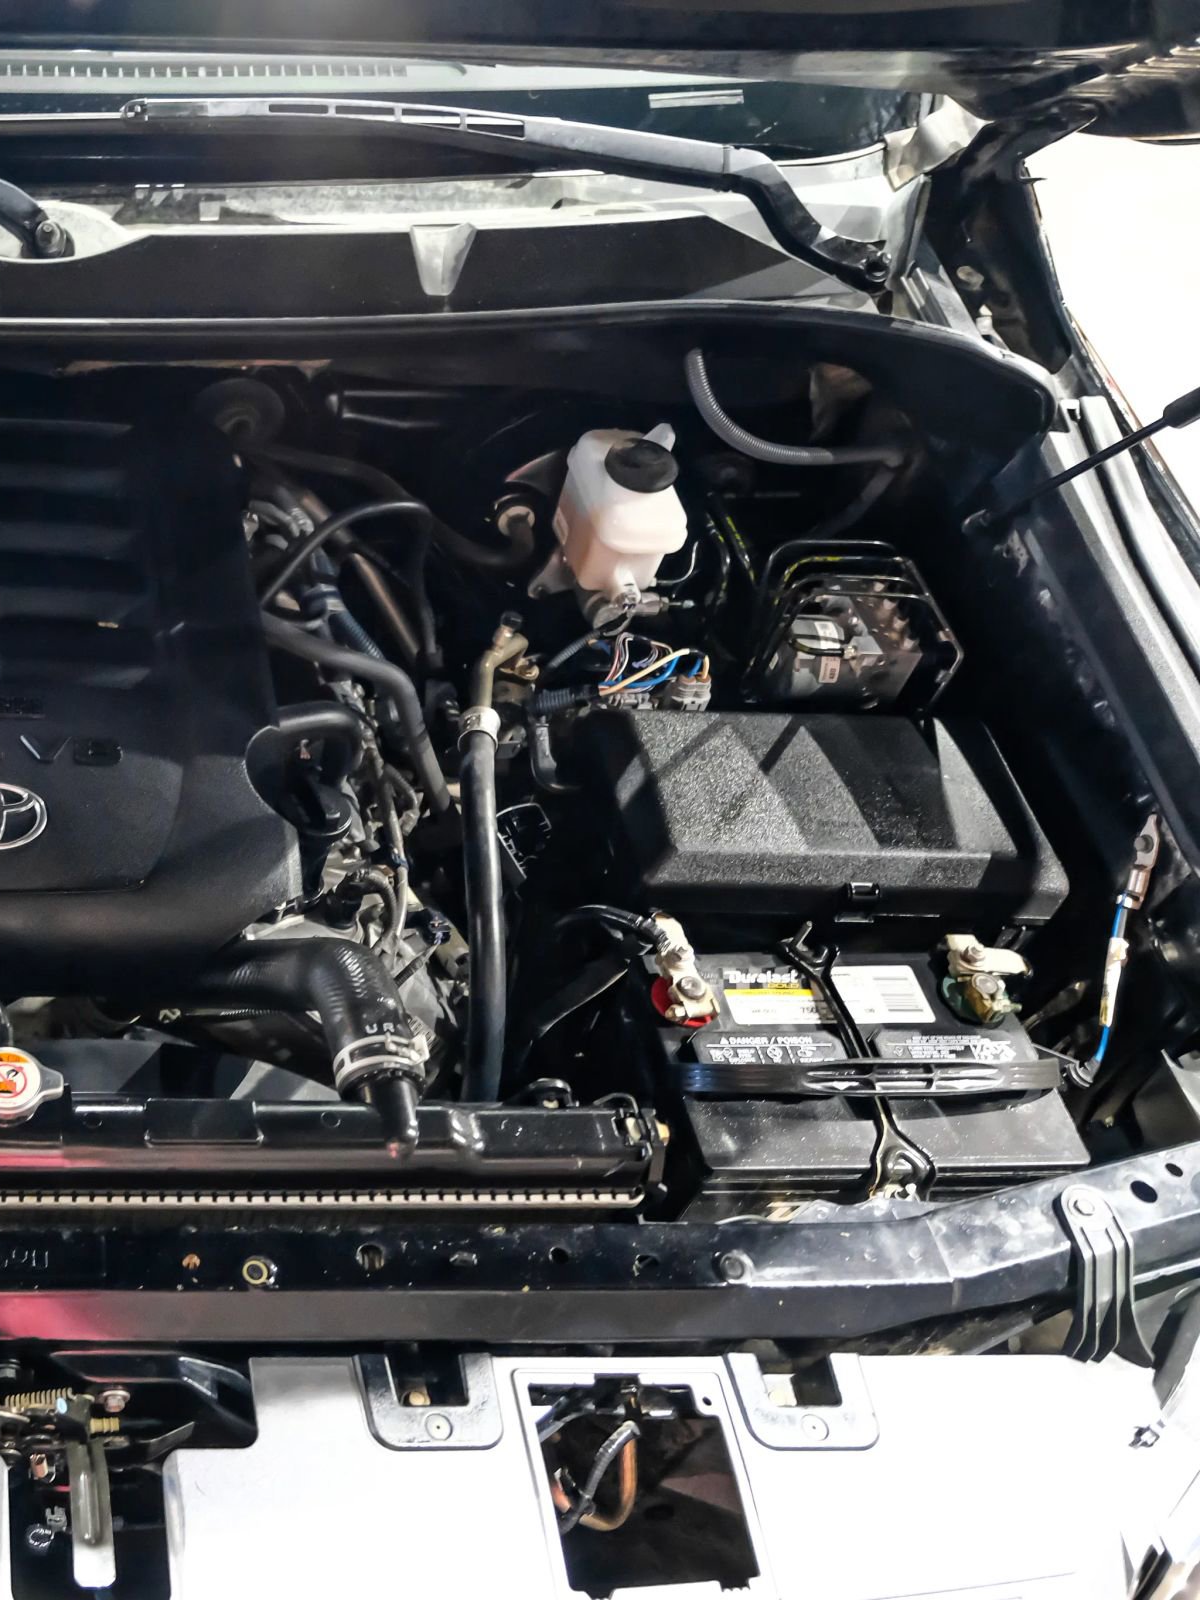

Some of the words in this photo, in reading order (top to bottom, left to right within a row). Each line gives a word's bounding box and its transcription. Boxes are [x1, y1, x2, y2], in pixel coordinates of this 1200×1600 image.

[722, 969, 799, 984] Duralast
[728, 1036, 769, 1045] DANGER
[776, 1036, 813, 1045] POISON
